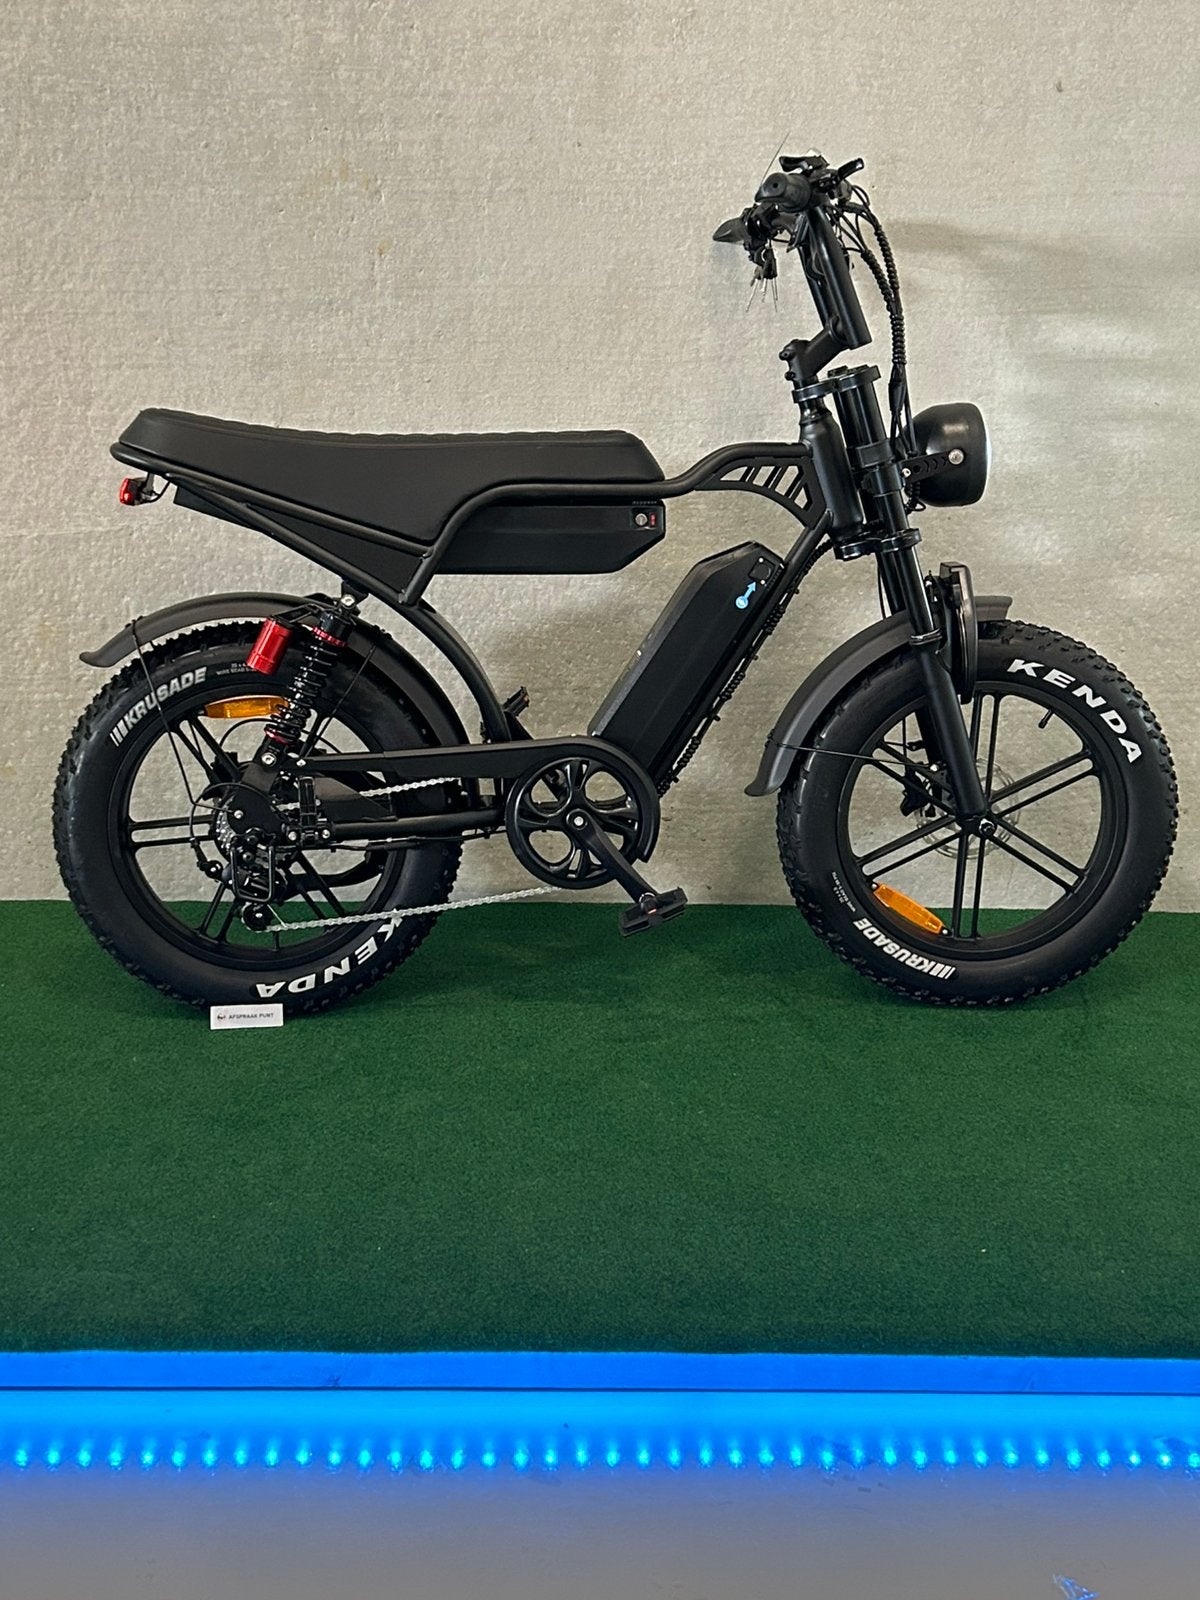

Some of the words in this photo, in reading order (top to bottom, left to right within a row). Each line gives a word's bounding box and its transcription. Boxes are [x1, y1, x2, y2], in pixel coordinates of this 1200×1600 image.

[124, 666, 208, 730] KRUSADE
[1007, 659, 1142, 763] KENDA
[256, 908, 403, 998] KENDA
[853, 917, 937, 974] KRUSADE
